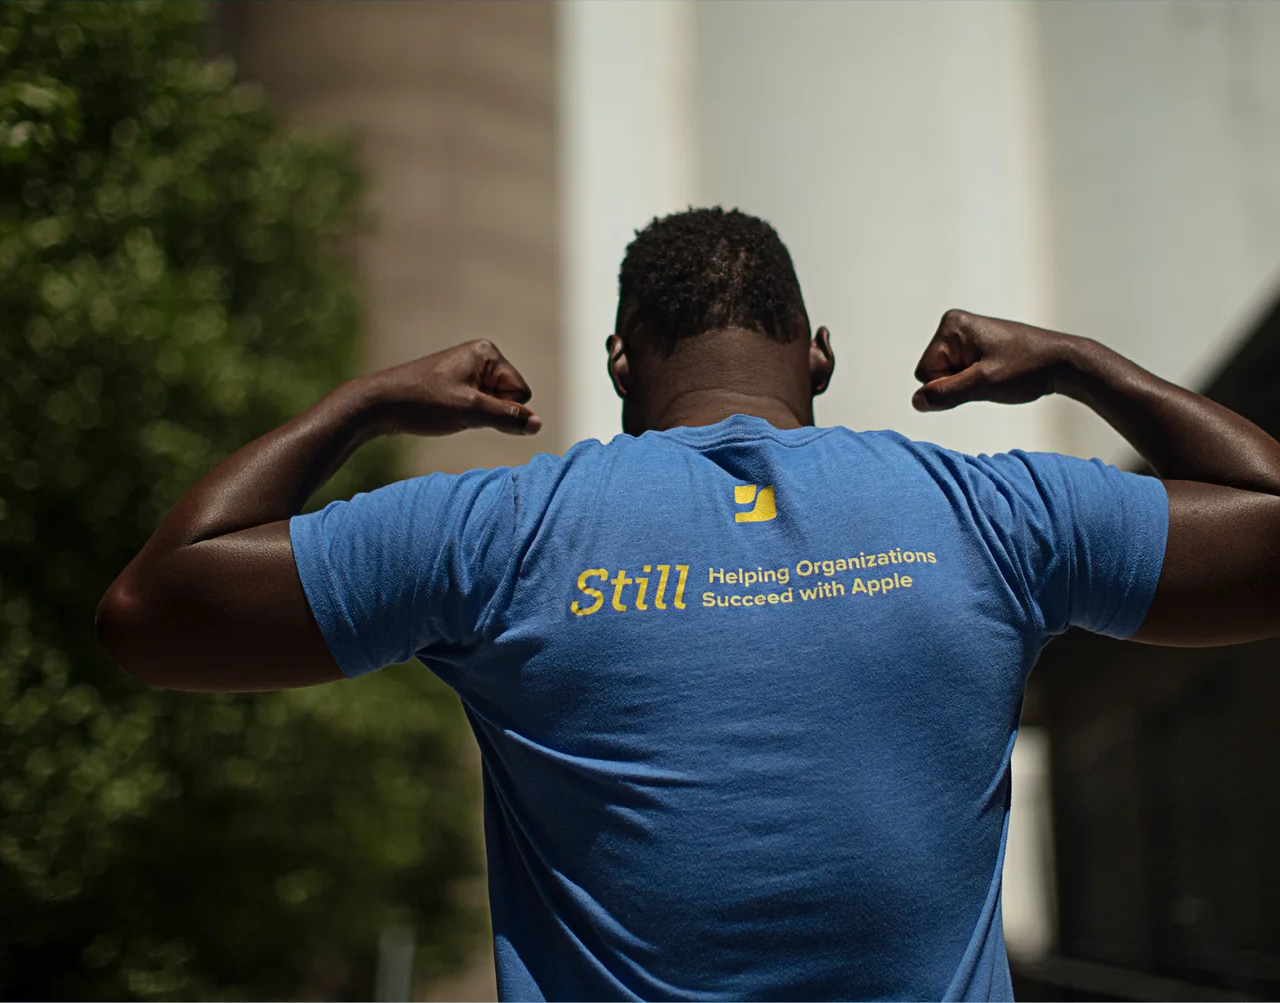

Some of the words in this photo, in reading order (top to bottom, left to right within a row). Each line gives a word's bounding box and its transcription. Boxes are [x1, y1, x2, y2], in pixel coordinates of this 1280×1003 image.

[708, 567, 790, 588] Helping
[795, 547, 937, 577] Organizations
[570, 564, 689, 616] Still
[702, 588, 793, 608] Succeed
[799, 581, 845, 601] with
[851, 573, 913, 596] Apple
